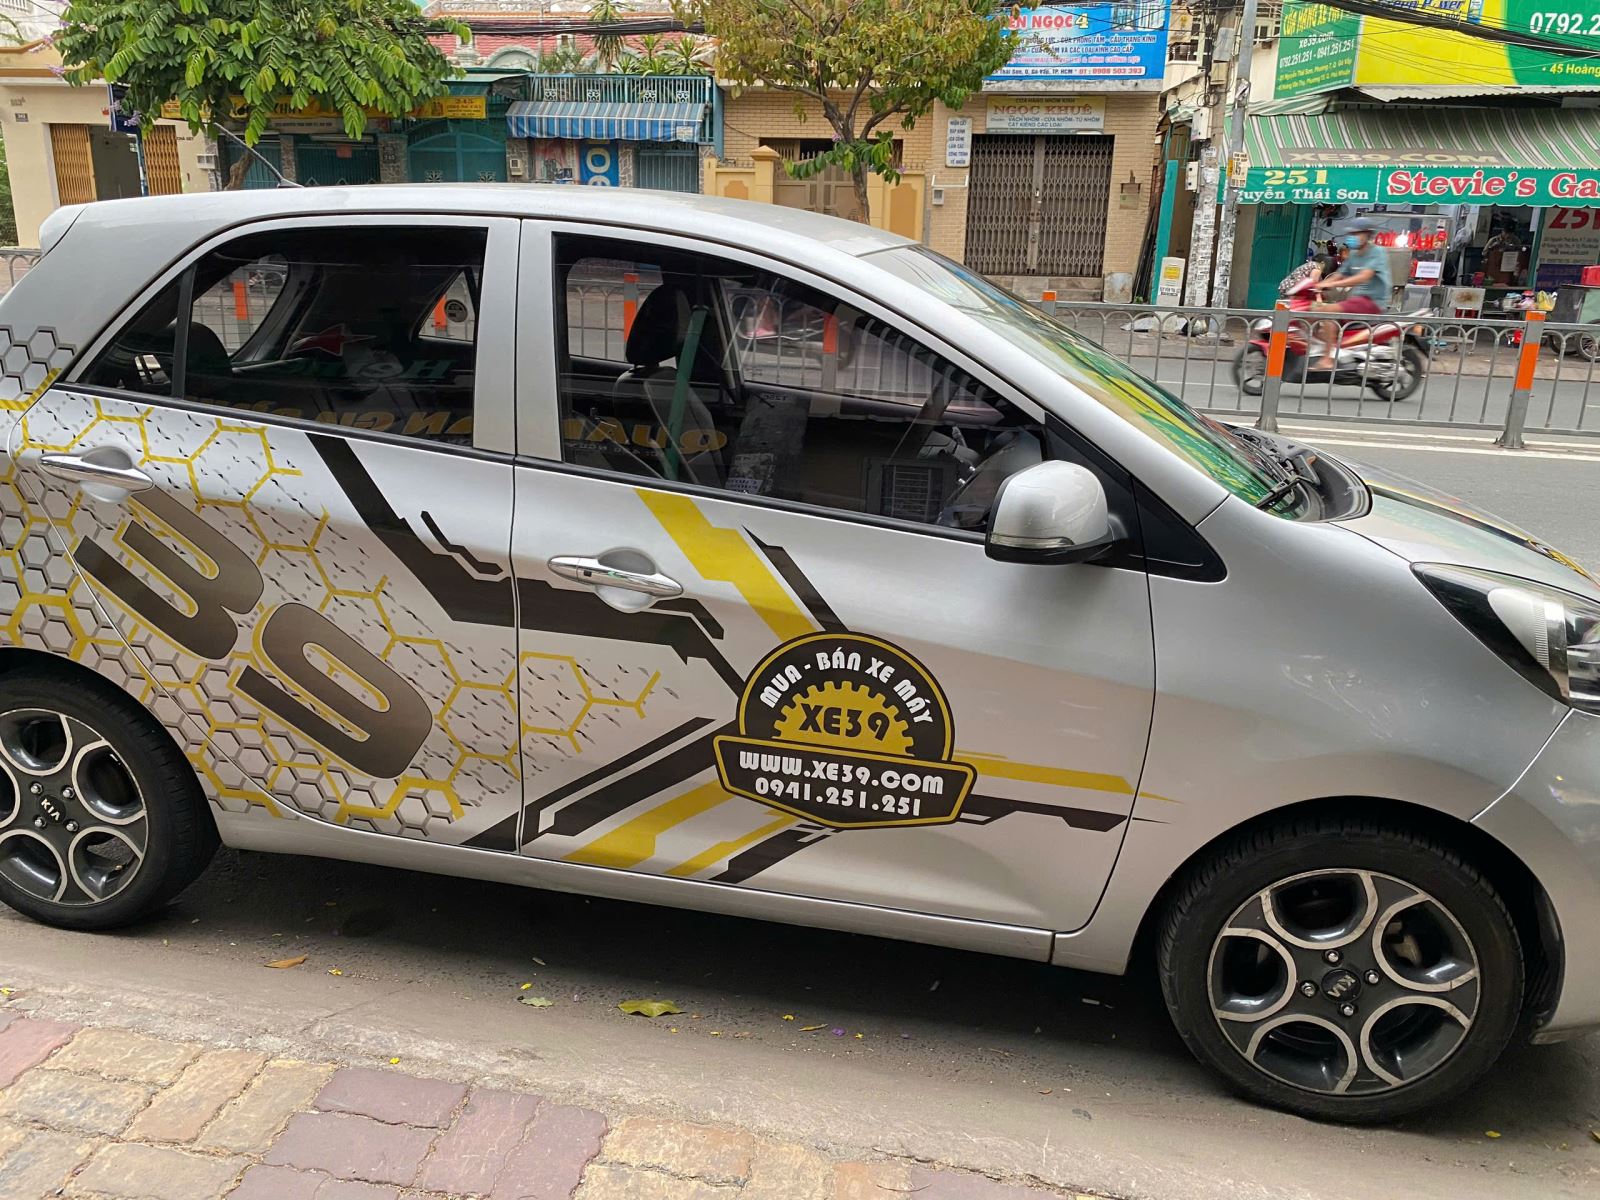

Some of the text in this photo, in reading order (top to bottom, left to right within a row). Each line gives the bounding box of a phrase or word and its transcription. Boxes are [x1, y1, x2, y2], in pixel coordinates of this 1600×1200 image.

[1074, 13, 1089, 29] 4
[1298, 31, 1335, 49] xe39.com
[1549, 64, 1564, 76] 45
[1289, 151, 1502, 165] XE39.COM
[1264, 169, 1328, 185] 251
[1230, 186, 1369, 202] guyễn Thái Sơn
[759, 664, 803, 709] MUA
[815, 646, 862, 671] BÁN
[865, 656, 896, 684] XE
[893, 679, 933, 723] MÁY
[799, 703, 890, 741] XE39
[755, 777, 921, 817] 0941.251.251
[40, 796, 61, 821] KIA
[1327, 974, 1356, 998] KIA
